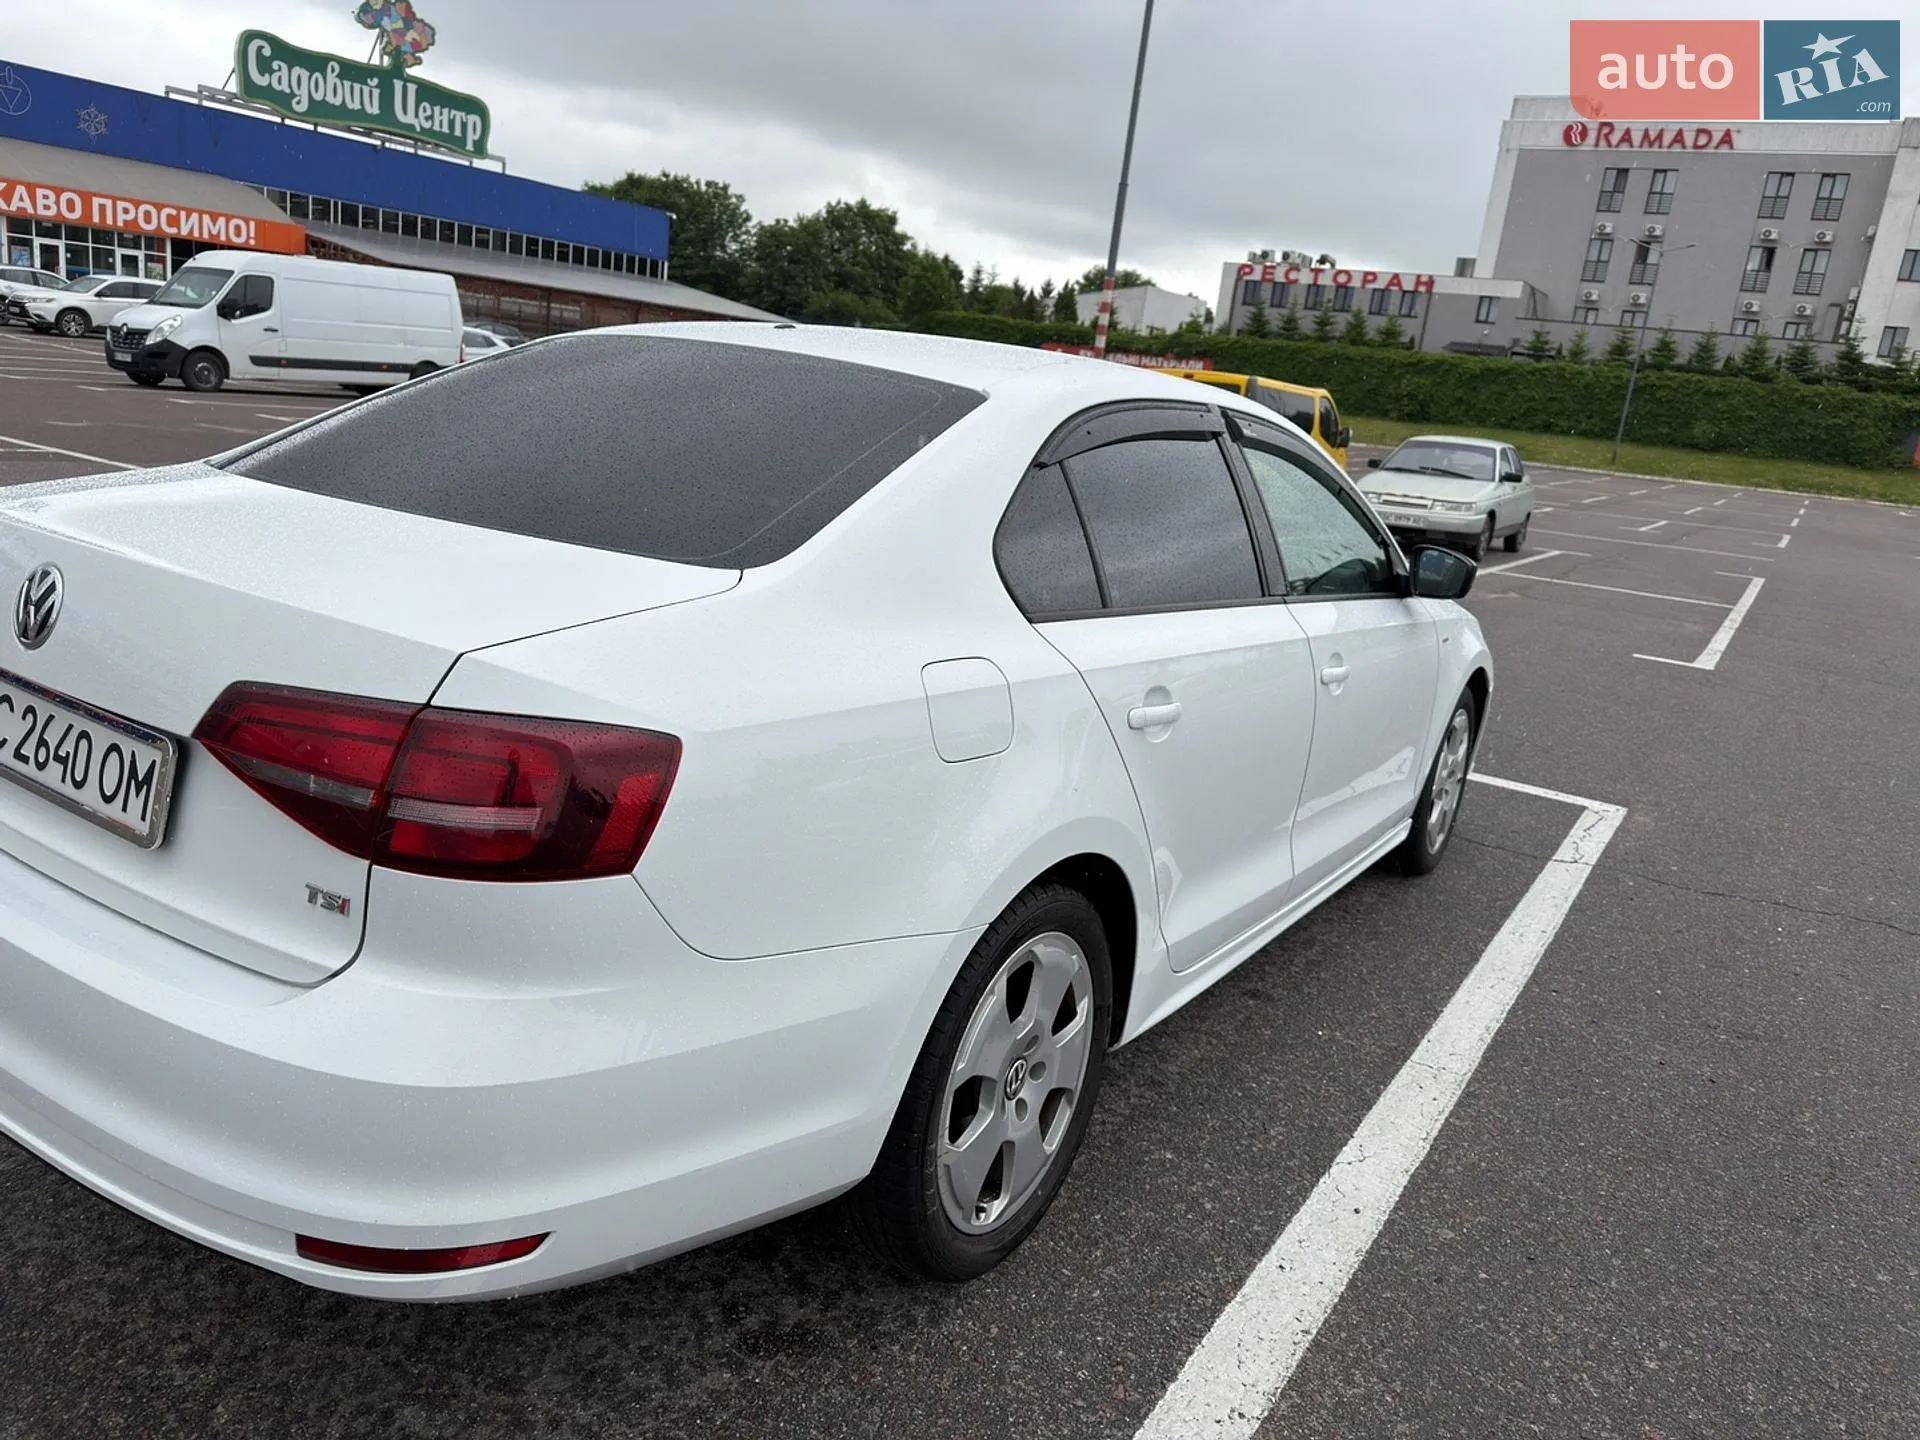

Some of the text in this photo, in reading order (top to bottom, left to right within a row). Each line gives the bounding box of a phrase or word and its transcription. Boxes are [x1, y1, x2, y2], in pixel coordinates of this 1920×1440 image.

[247, 38, 483, 150] Садовий Центр
[1594, 121, 1734, 150] RAMADA
[91, 196, 256, 246] ПРОСИМО!
[1237, 263, 1435, 294] РЕСТОРАН
[13, 704, 93, 790] 2640
[98, 742, 157, 822] OM
[304, 881, 351, 918] TSI
